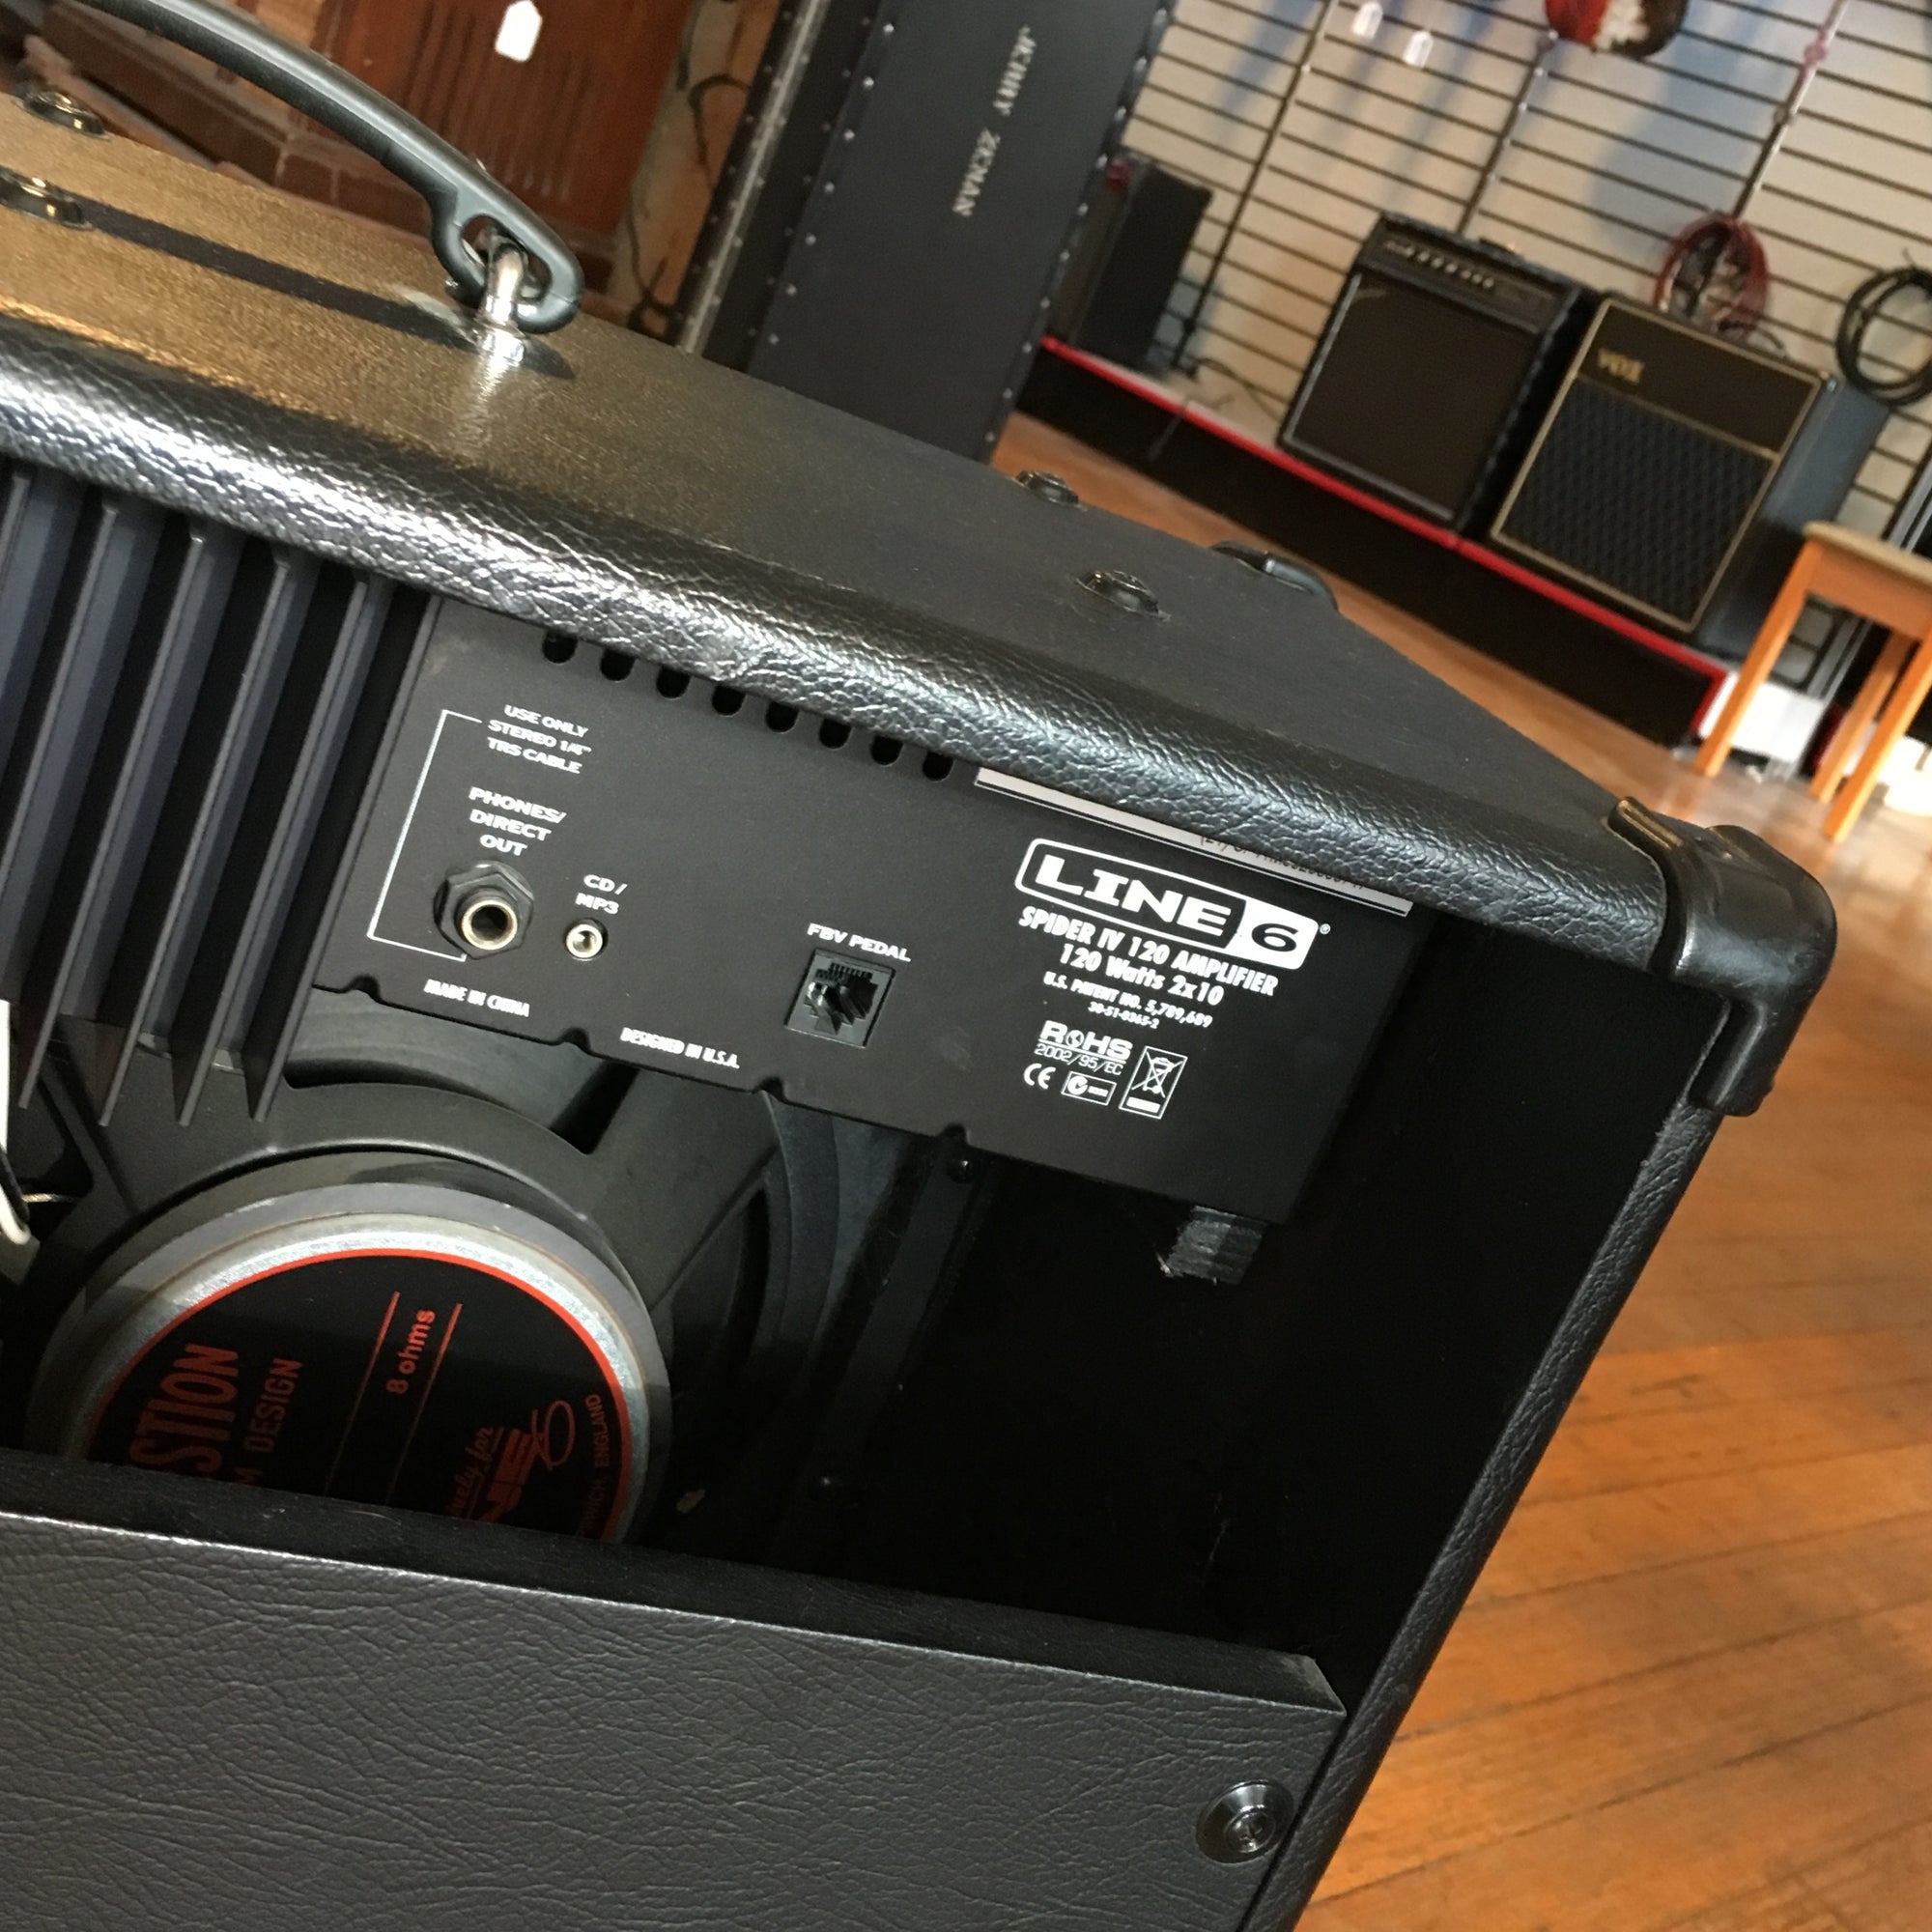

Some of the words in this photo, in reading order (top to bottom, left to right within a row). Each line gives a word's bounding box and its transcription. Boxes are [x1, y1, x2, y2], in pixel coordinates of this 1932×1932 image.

[952, 128, 1001, 217] ZEMAN
[488, 720, 556, 747] STEREO
[504, 705, 540, 726] USE
[541, 715, 588, 738] ONLY
[487, 737, 522, 759] TRS
[523, 748, 582, 774] CABLE
[469, 786, 567, 824] PHONES/
[469, 809, 552, 841] DIRECT
[479, 835, 527, 856] OUT
[575, 893, 620, 915] MP3
[1036, 855, 1231, 935] LINE
[1251, 922, 1299, 952] 6
[807, 923, 848, 944] FBV
[848, 934, 911, 962] PEDAL
[1019, 907, 1094, 945] SPIDER
[1095, 925, 1124, 952] IV
[1129, 934, 1170, 965] 120
[1173, 952, 1280, 996] AMPLIFIER
[1043, 972, 1068, 991] U.S.
[1069, 978, 1119, 1004] PATENT
[1119, 991, 1143, 1010] NO.
[1062, 943, 1102, 972] 120
[1104, 954, 1165, 990] Watts
[1168, 976, 1224, 1006] 2x10
[423, 978, 468, 1002] MADE
[468, 989, 487, 1006] IN
[486, 994, 530, 1017] CHINA
[619, 1027, 685, 1055] DESIGNED
[684, 1042, 703, 1060] IN
[1034, 1042, 1124, 1076] 2002/95/EC
[386, 1378, 409, 1395] 8
[398, 1309, 437, 1376] ohms
[242, 1356, 304, 1454] DESIGN
[584, 1393, 611, 1468] ENGLAND
